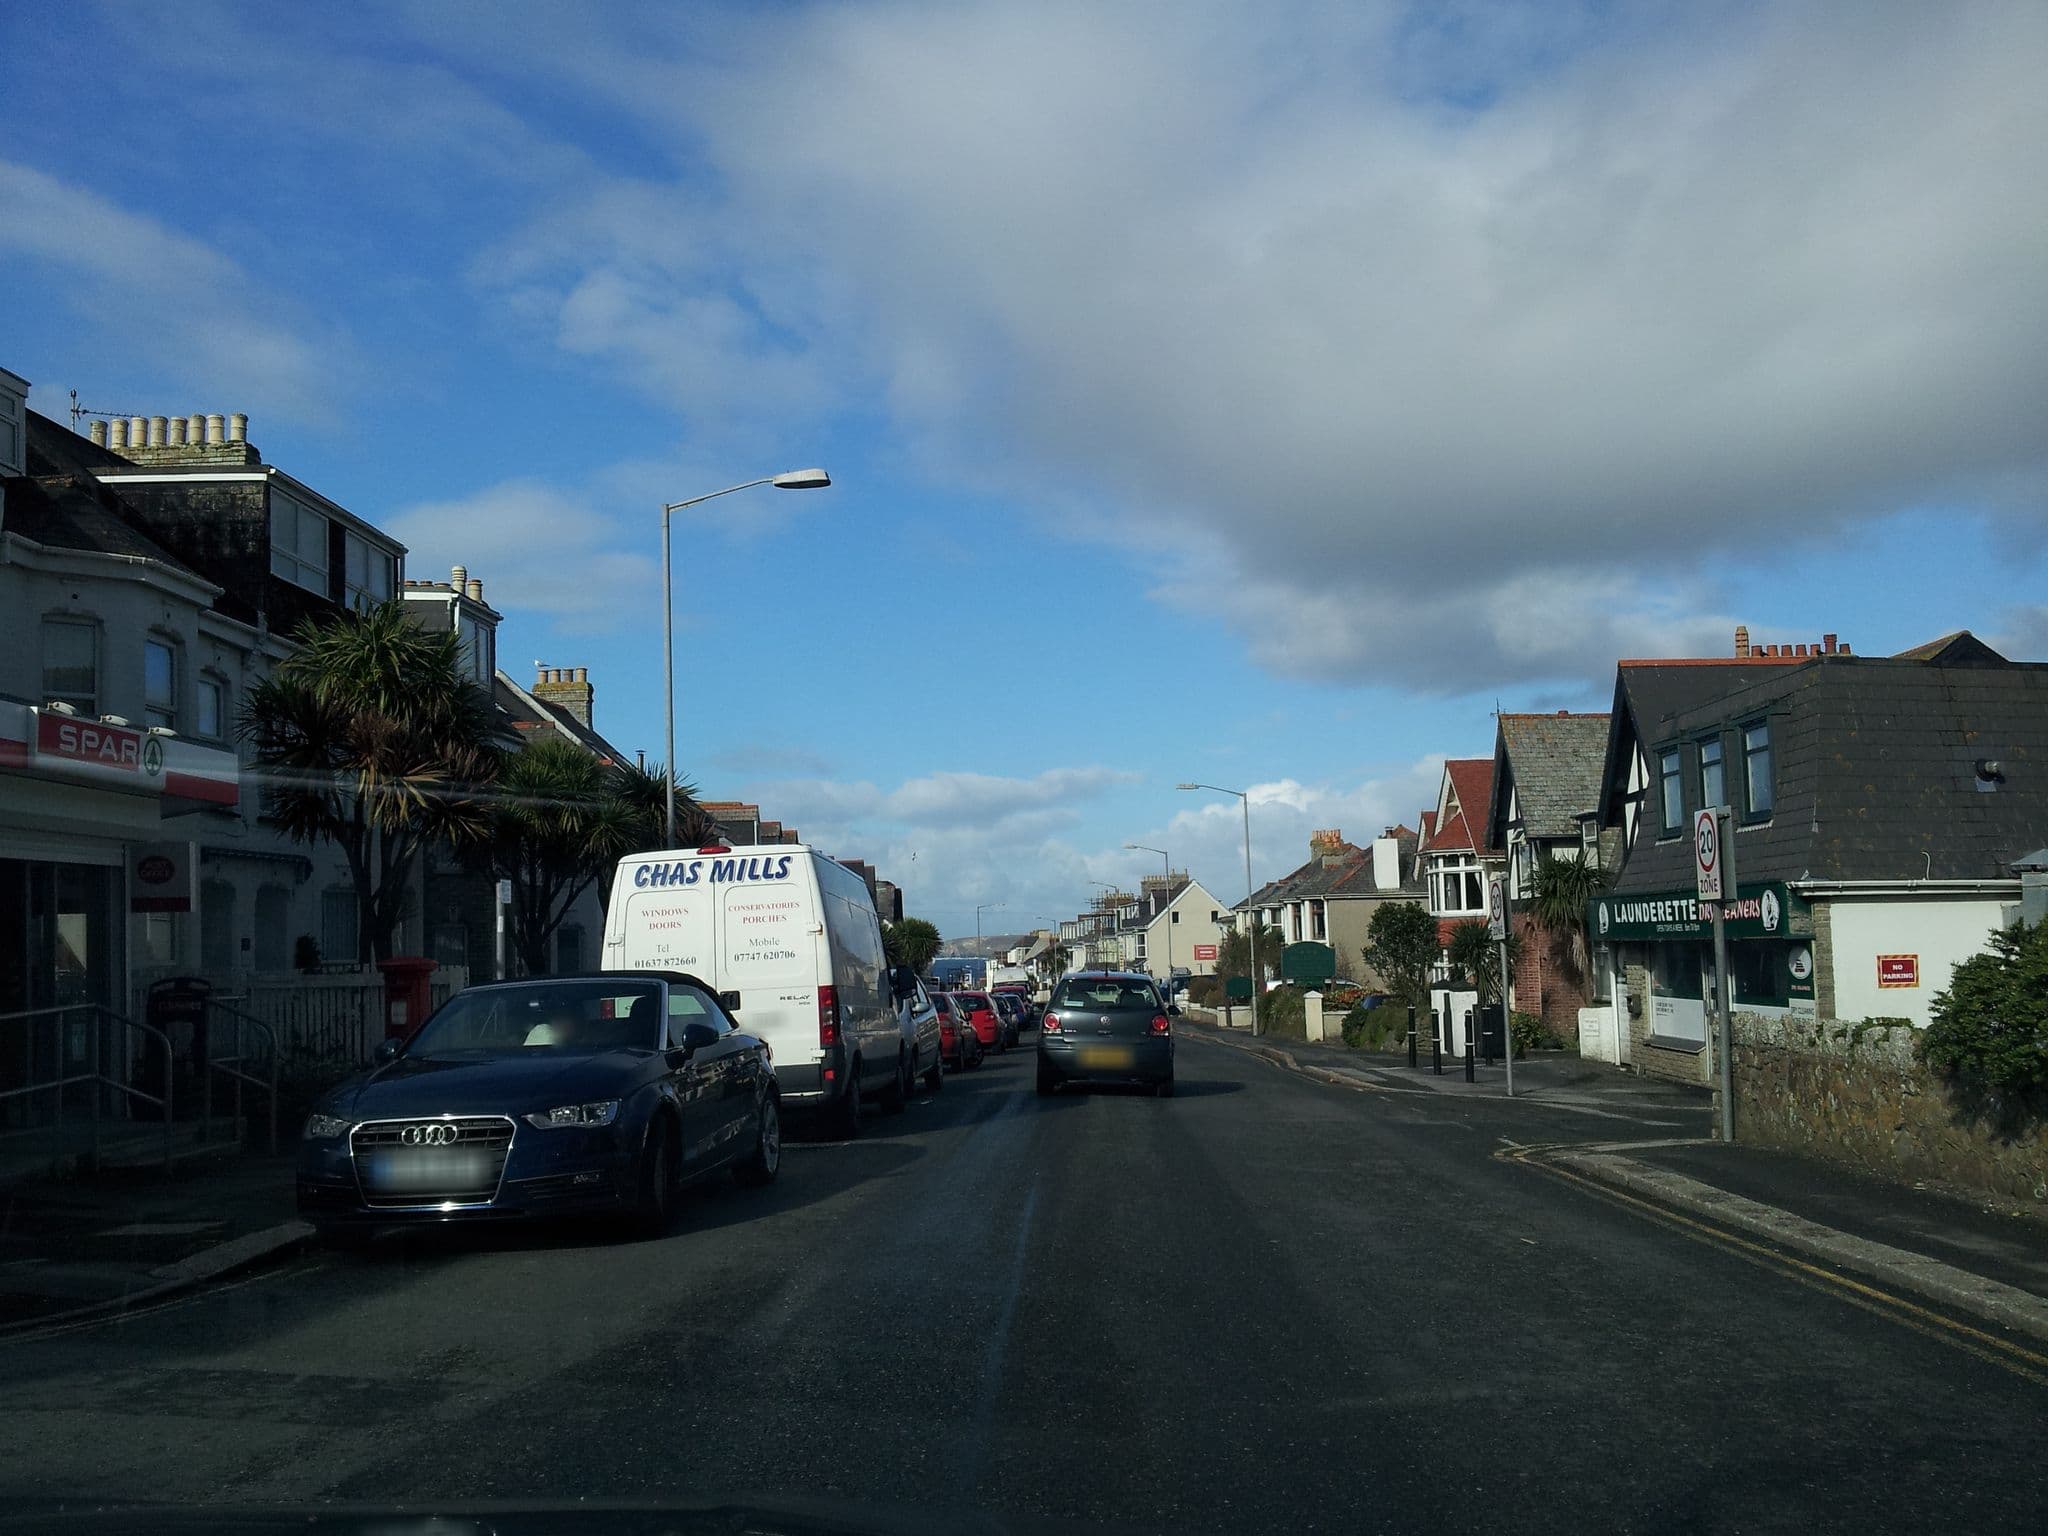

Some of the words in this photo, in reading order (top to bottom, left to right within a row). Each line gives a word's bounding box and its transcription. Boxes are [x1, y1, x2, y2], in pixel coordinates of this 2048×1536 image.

[58, 724, 139, 765] SPAR
[1699, 828, 1714, 854] 20
[634, 861, 704, 889] CHAS
[709, 856, 793, 884] MILLS
[1699, 878, 1719, 894] ZONE
[641, 907, 690, 918] WINDOWS
[727, 902, 800, 911] CONSERVATORIES
[1614, 898, 1697, 924] LAUNDERETTE
[648, 920, 682, 931] DOORS
[742, 914, 788, 925] PORCHES
[656, 943, 670, 953] Tel
[749, 937, 781, 948] Mobile
[733, 951, 763, 962] 07747
[763, 950, 796, 961] 620706
[634, 958, 661, 969] 01637
[664, 956, 697, 967] 872660
